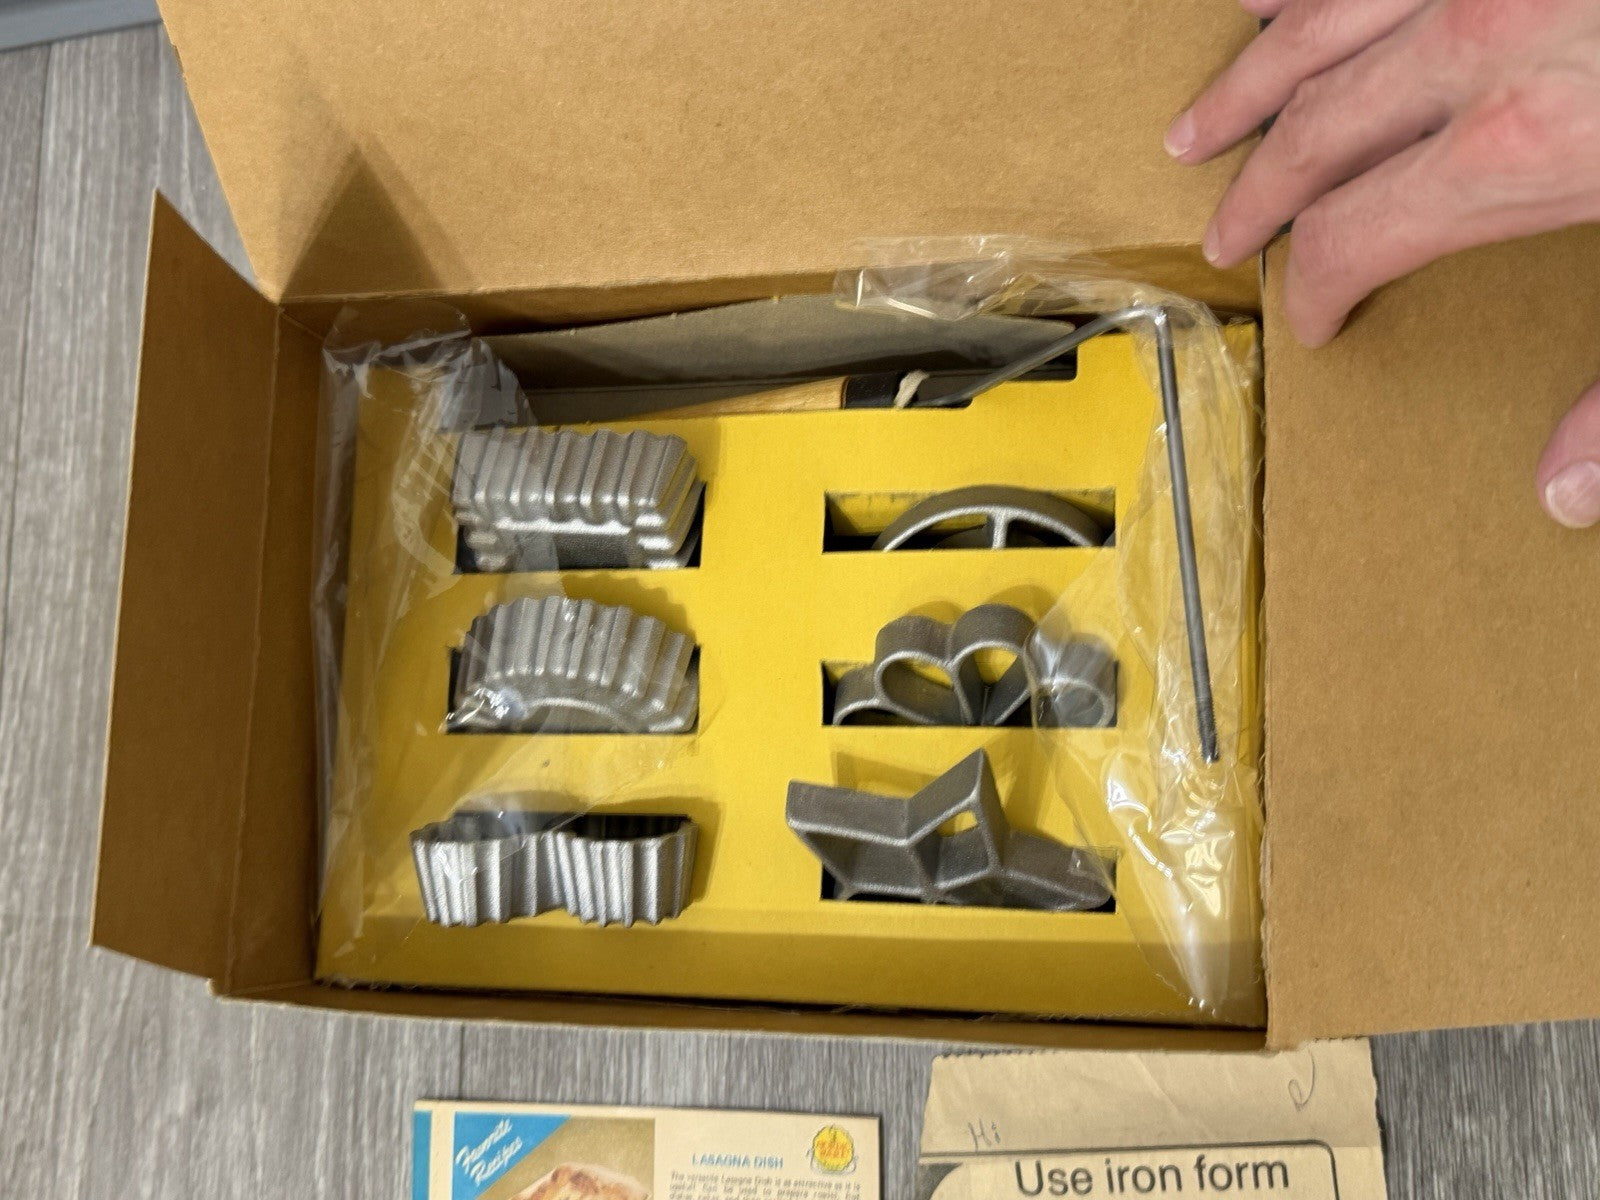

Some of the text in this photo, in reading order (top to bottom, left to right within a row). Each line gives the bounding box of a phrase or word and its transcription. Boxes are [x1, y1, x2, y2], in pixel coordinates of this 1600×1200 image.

[692, 1153, 784, 1169] LASAGNA DISH
[1014, 1154, 1289, 1196] Use iron form
